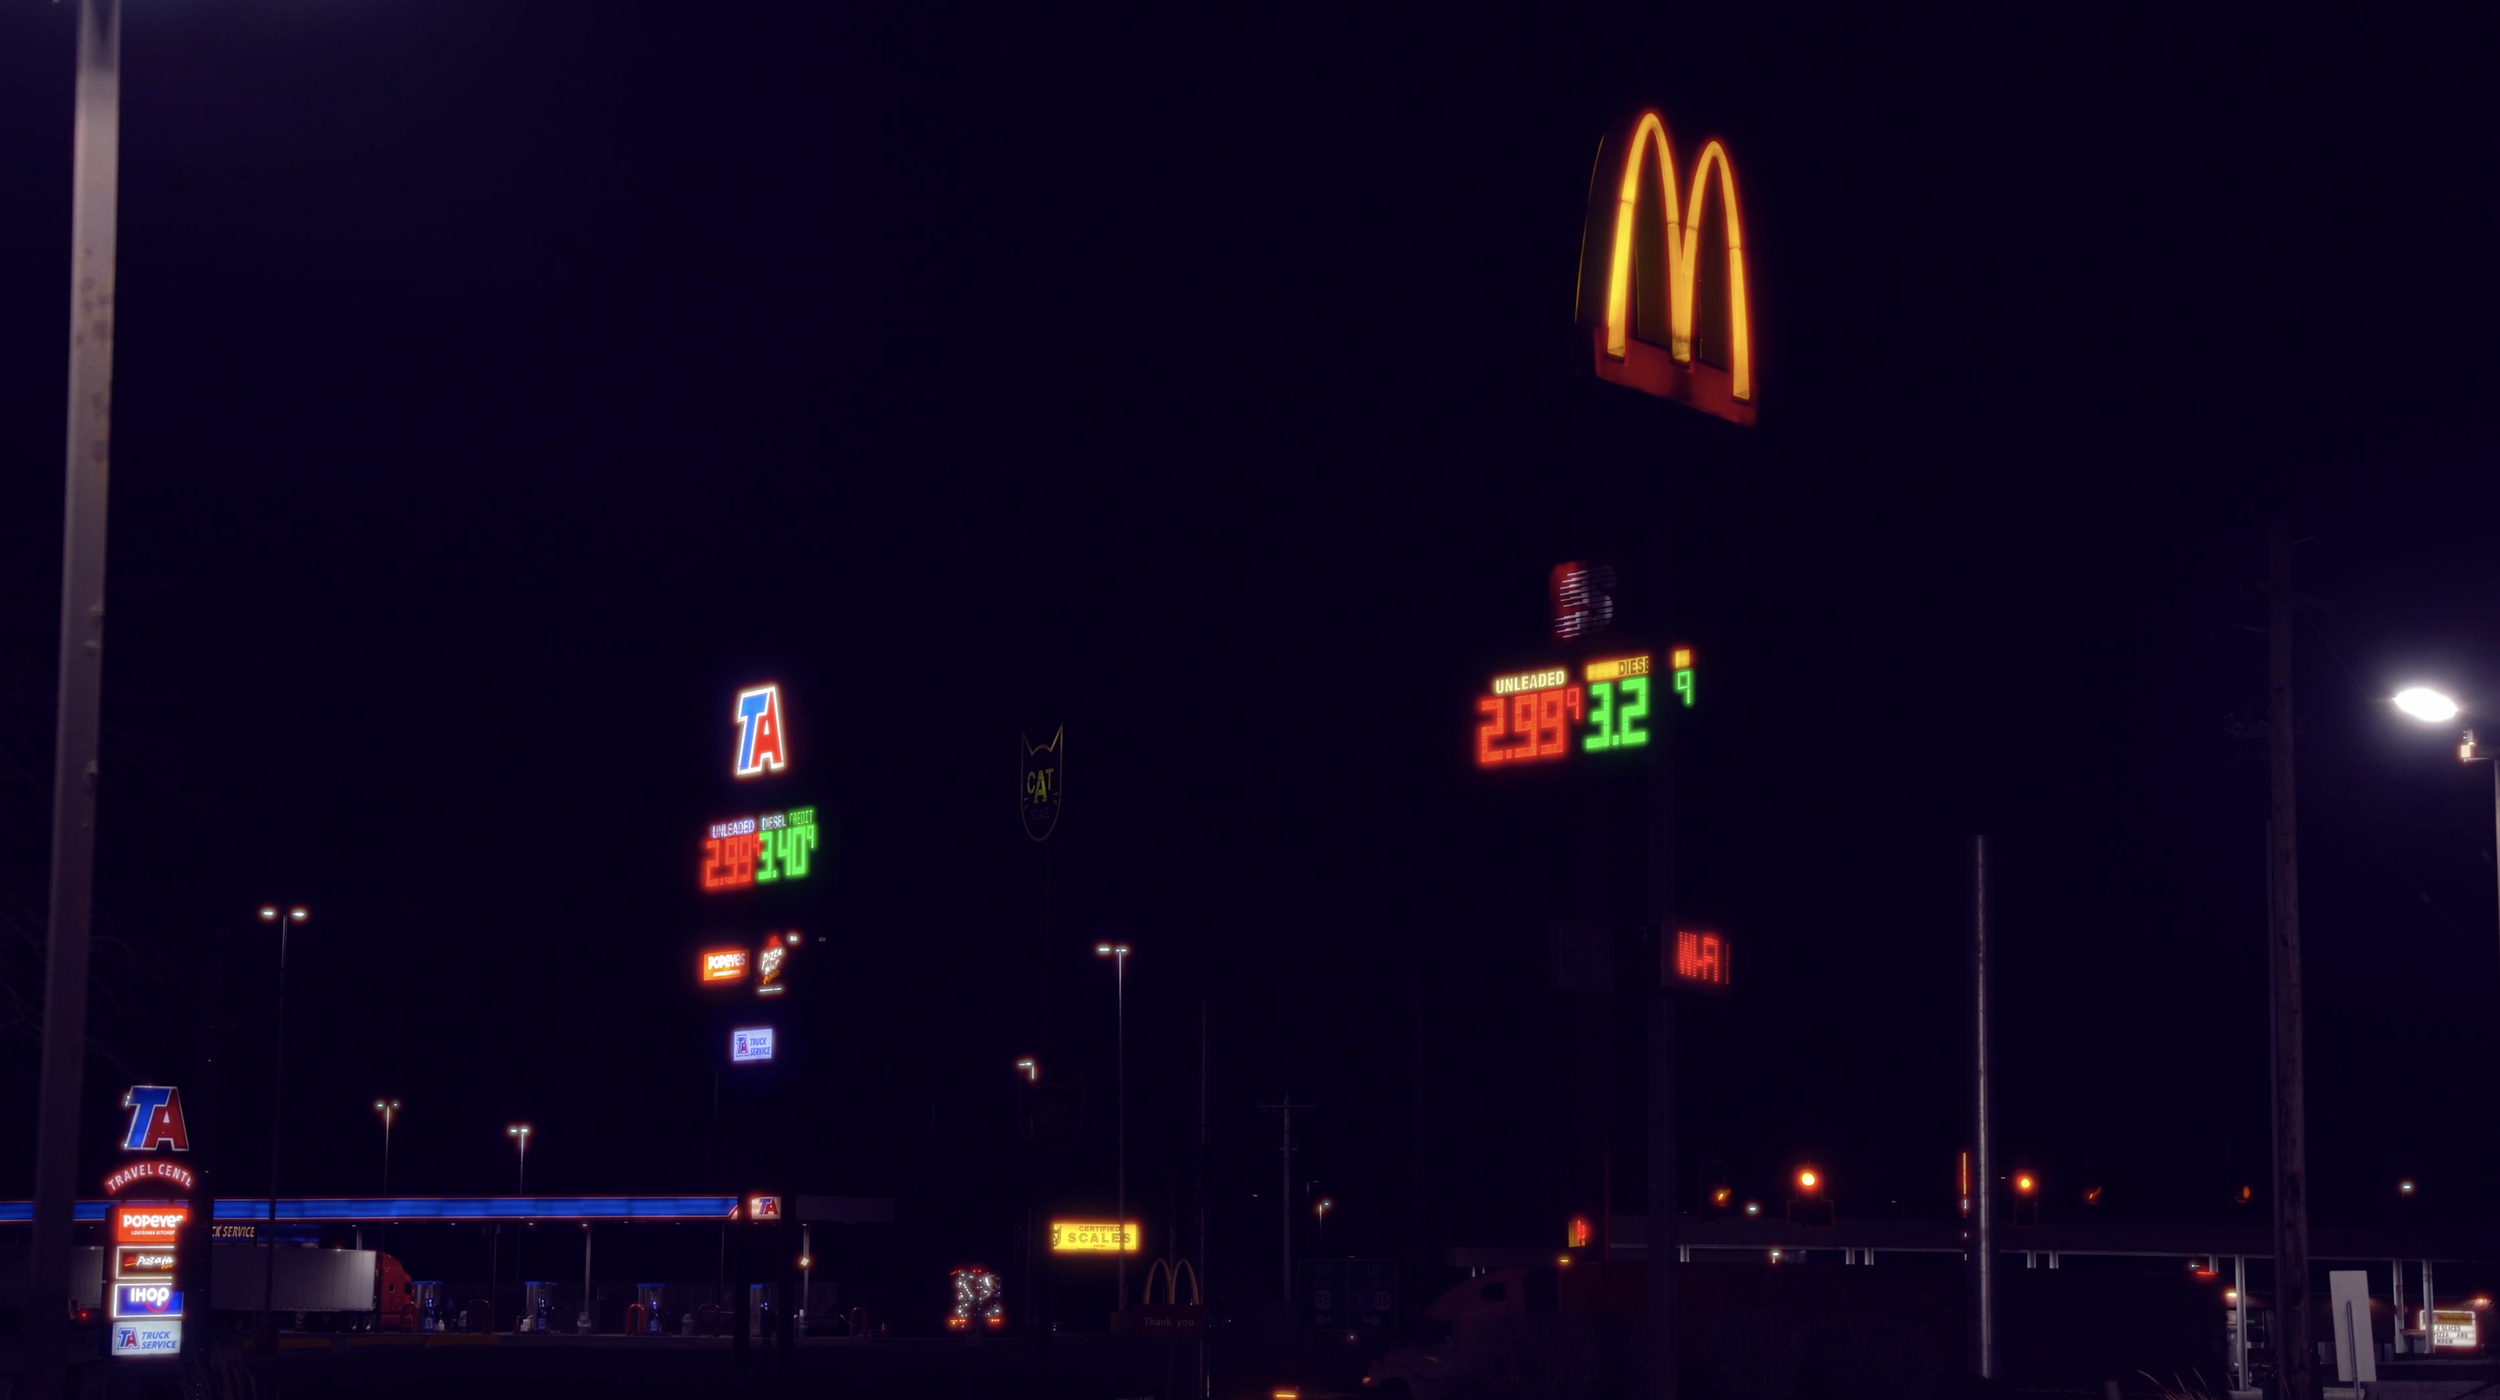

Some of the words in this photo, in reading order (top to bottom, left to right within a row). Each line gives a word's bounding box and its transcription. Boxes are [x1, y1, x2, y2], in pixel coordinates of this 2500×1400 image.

[1495, 670, 1565, 694] UNLEADED
[737, 687, 784, 775] TA
[1027, 767, 1054, 804] CAT
[712, 819, 755, 838] UNLEADED
[761, 814, 787, 831] DIESEL
[750, 1037, 767, 1047] TRUCK
[750, 1046, 771, 1056] SERVICE
[125, 1085, 189, 1151] TA
[108, 1164, 153, 1191] TRAVEL
[759, 1197, 779, 1215] TA
[222, 1226, 255, 1238] SERVICE
[1067, 1232, 1132, 1244] SCALES
[1143, 1317, 1173, 1327] Thank
[1176, 1319, 1195, 1328] you
[117, 1327, 140, 1350] TA
[141, 1331, 171, 1341] TRUCK
[141, 1341, 177, 1350] SERVICE
